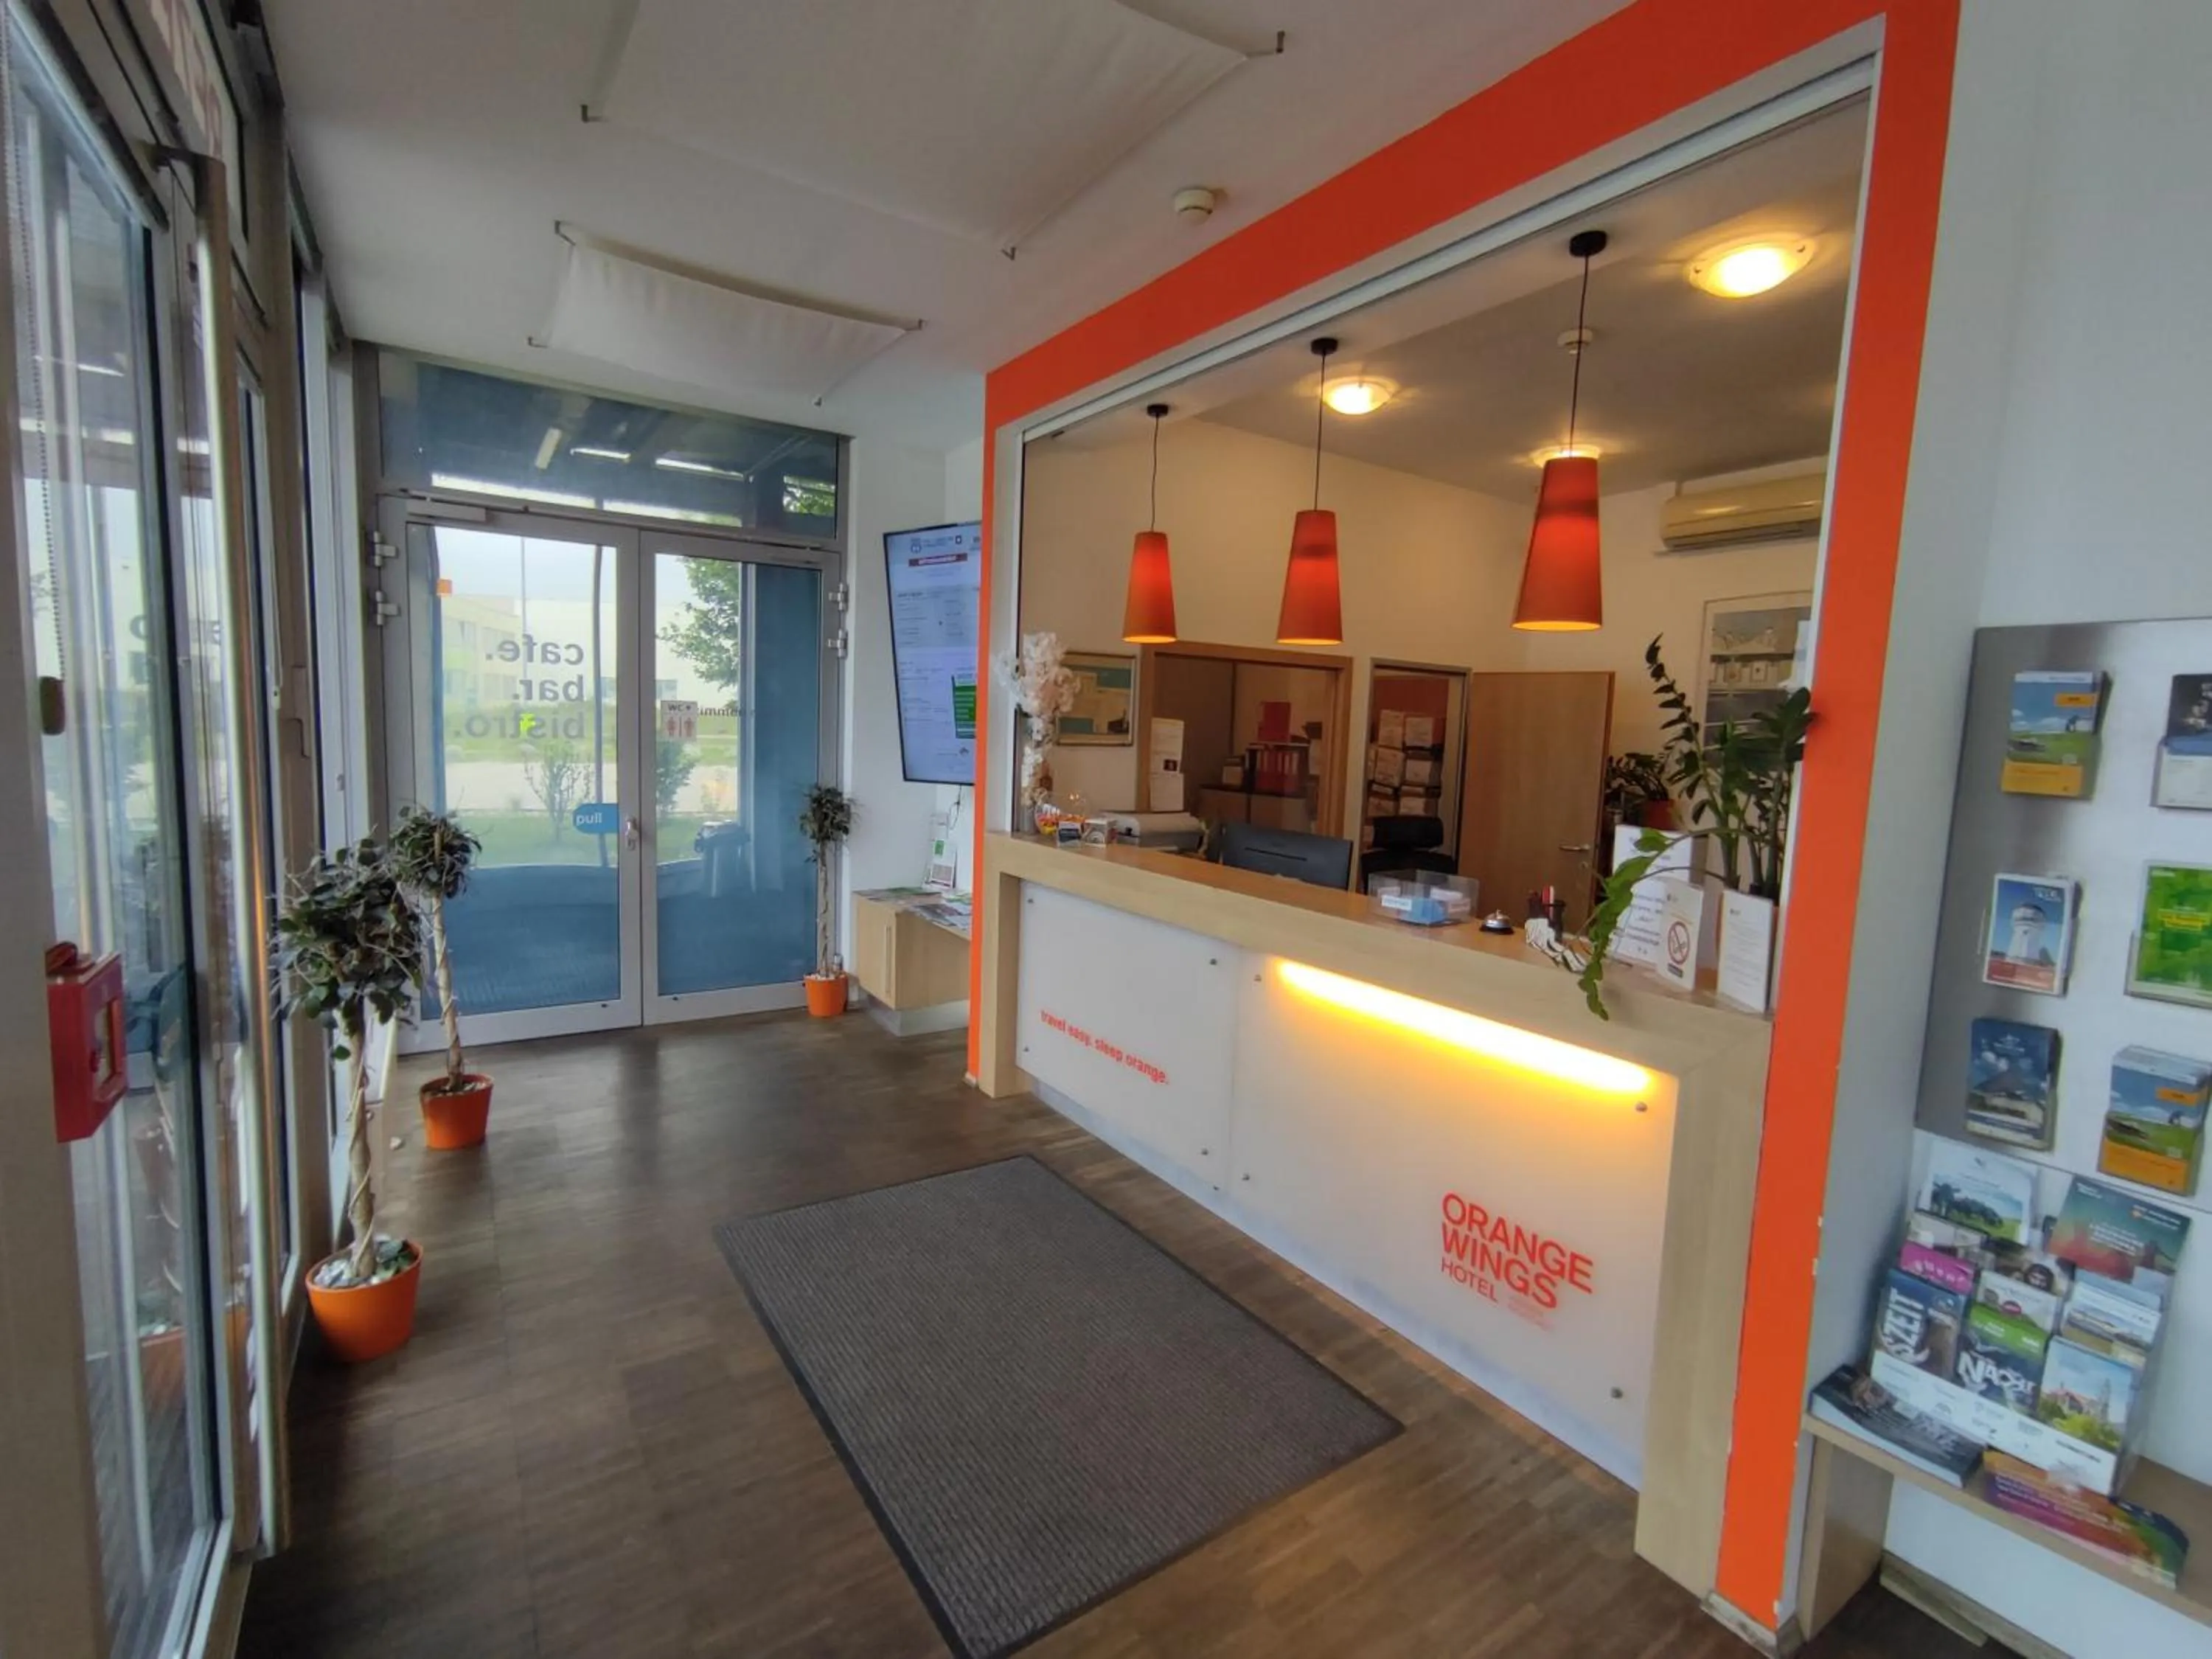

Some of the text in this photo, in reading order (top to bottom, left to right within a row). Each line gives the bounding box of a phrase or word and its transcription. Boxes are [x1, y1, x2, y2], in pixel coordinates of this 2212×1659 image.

[576, 813, 602, 827] pull
[1040, 1010, 1066, 1033] travel
[1095, 1038, 1123, 1062] sleep
[1442, 1192, 1593, 1295] ORANGE
[1442, 1221, 1557, 1309] WINGS
[1441, 1256, 1498, 1304] HOTEL
